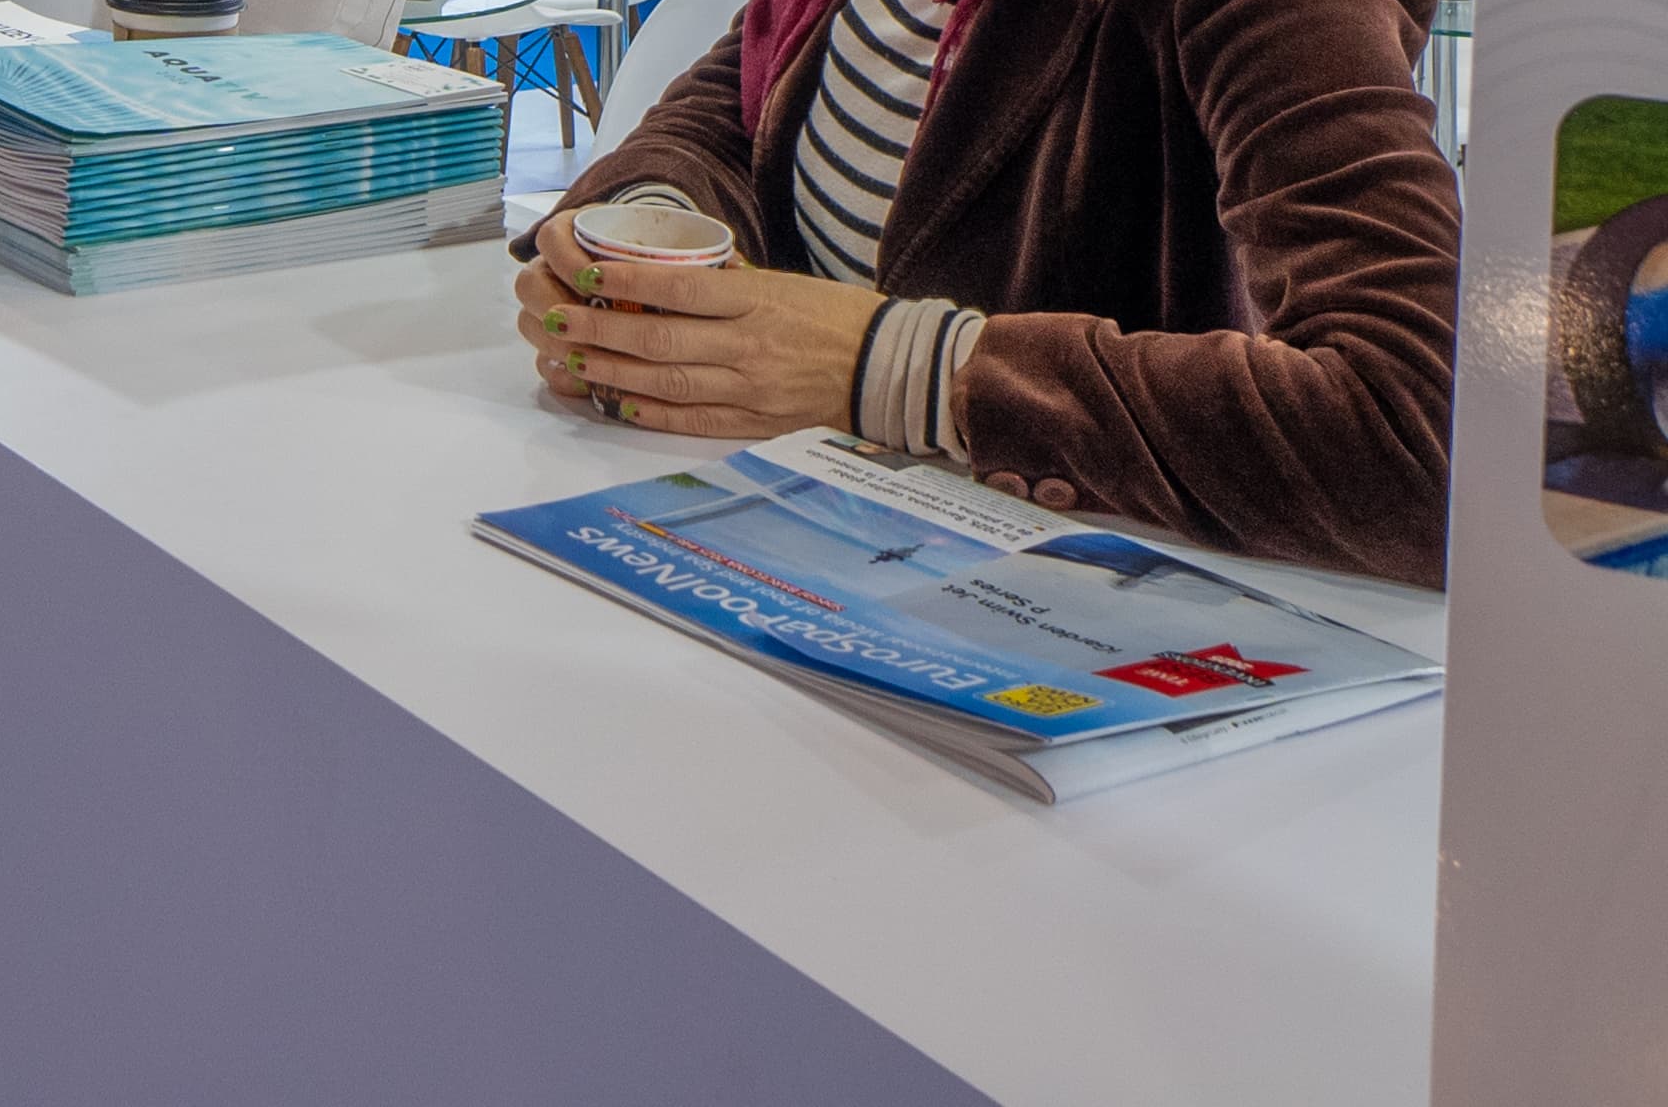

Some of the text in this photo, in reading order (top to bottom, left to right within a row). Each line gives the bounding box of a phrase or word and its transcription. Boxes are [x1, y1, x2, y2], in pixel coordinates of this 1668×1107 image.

[567, 525, 989, 690] EuroSpaPoolNews
[941, 583, 1123, 655] iGarden Swim Jet
[969, 578, 1031, 607] Series
